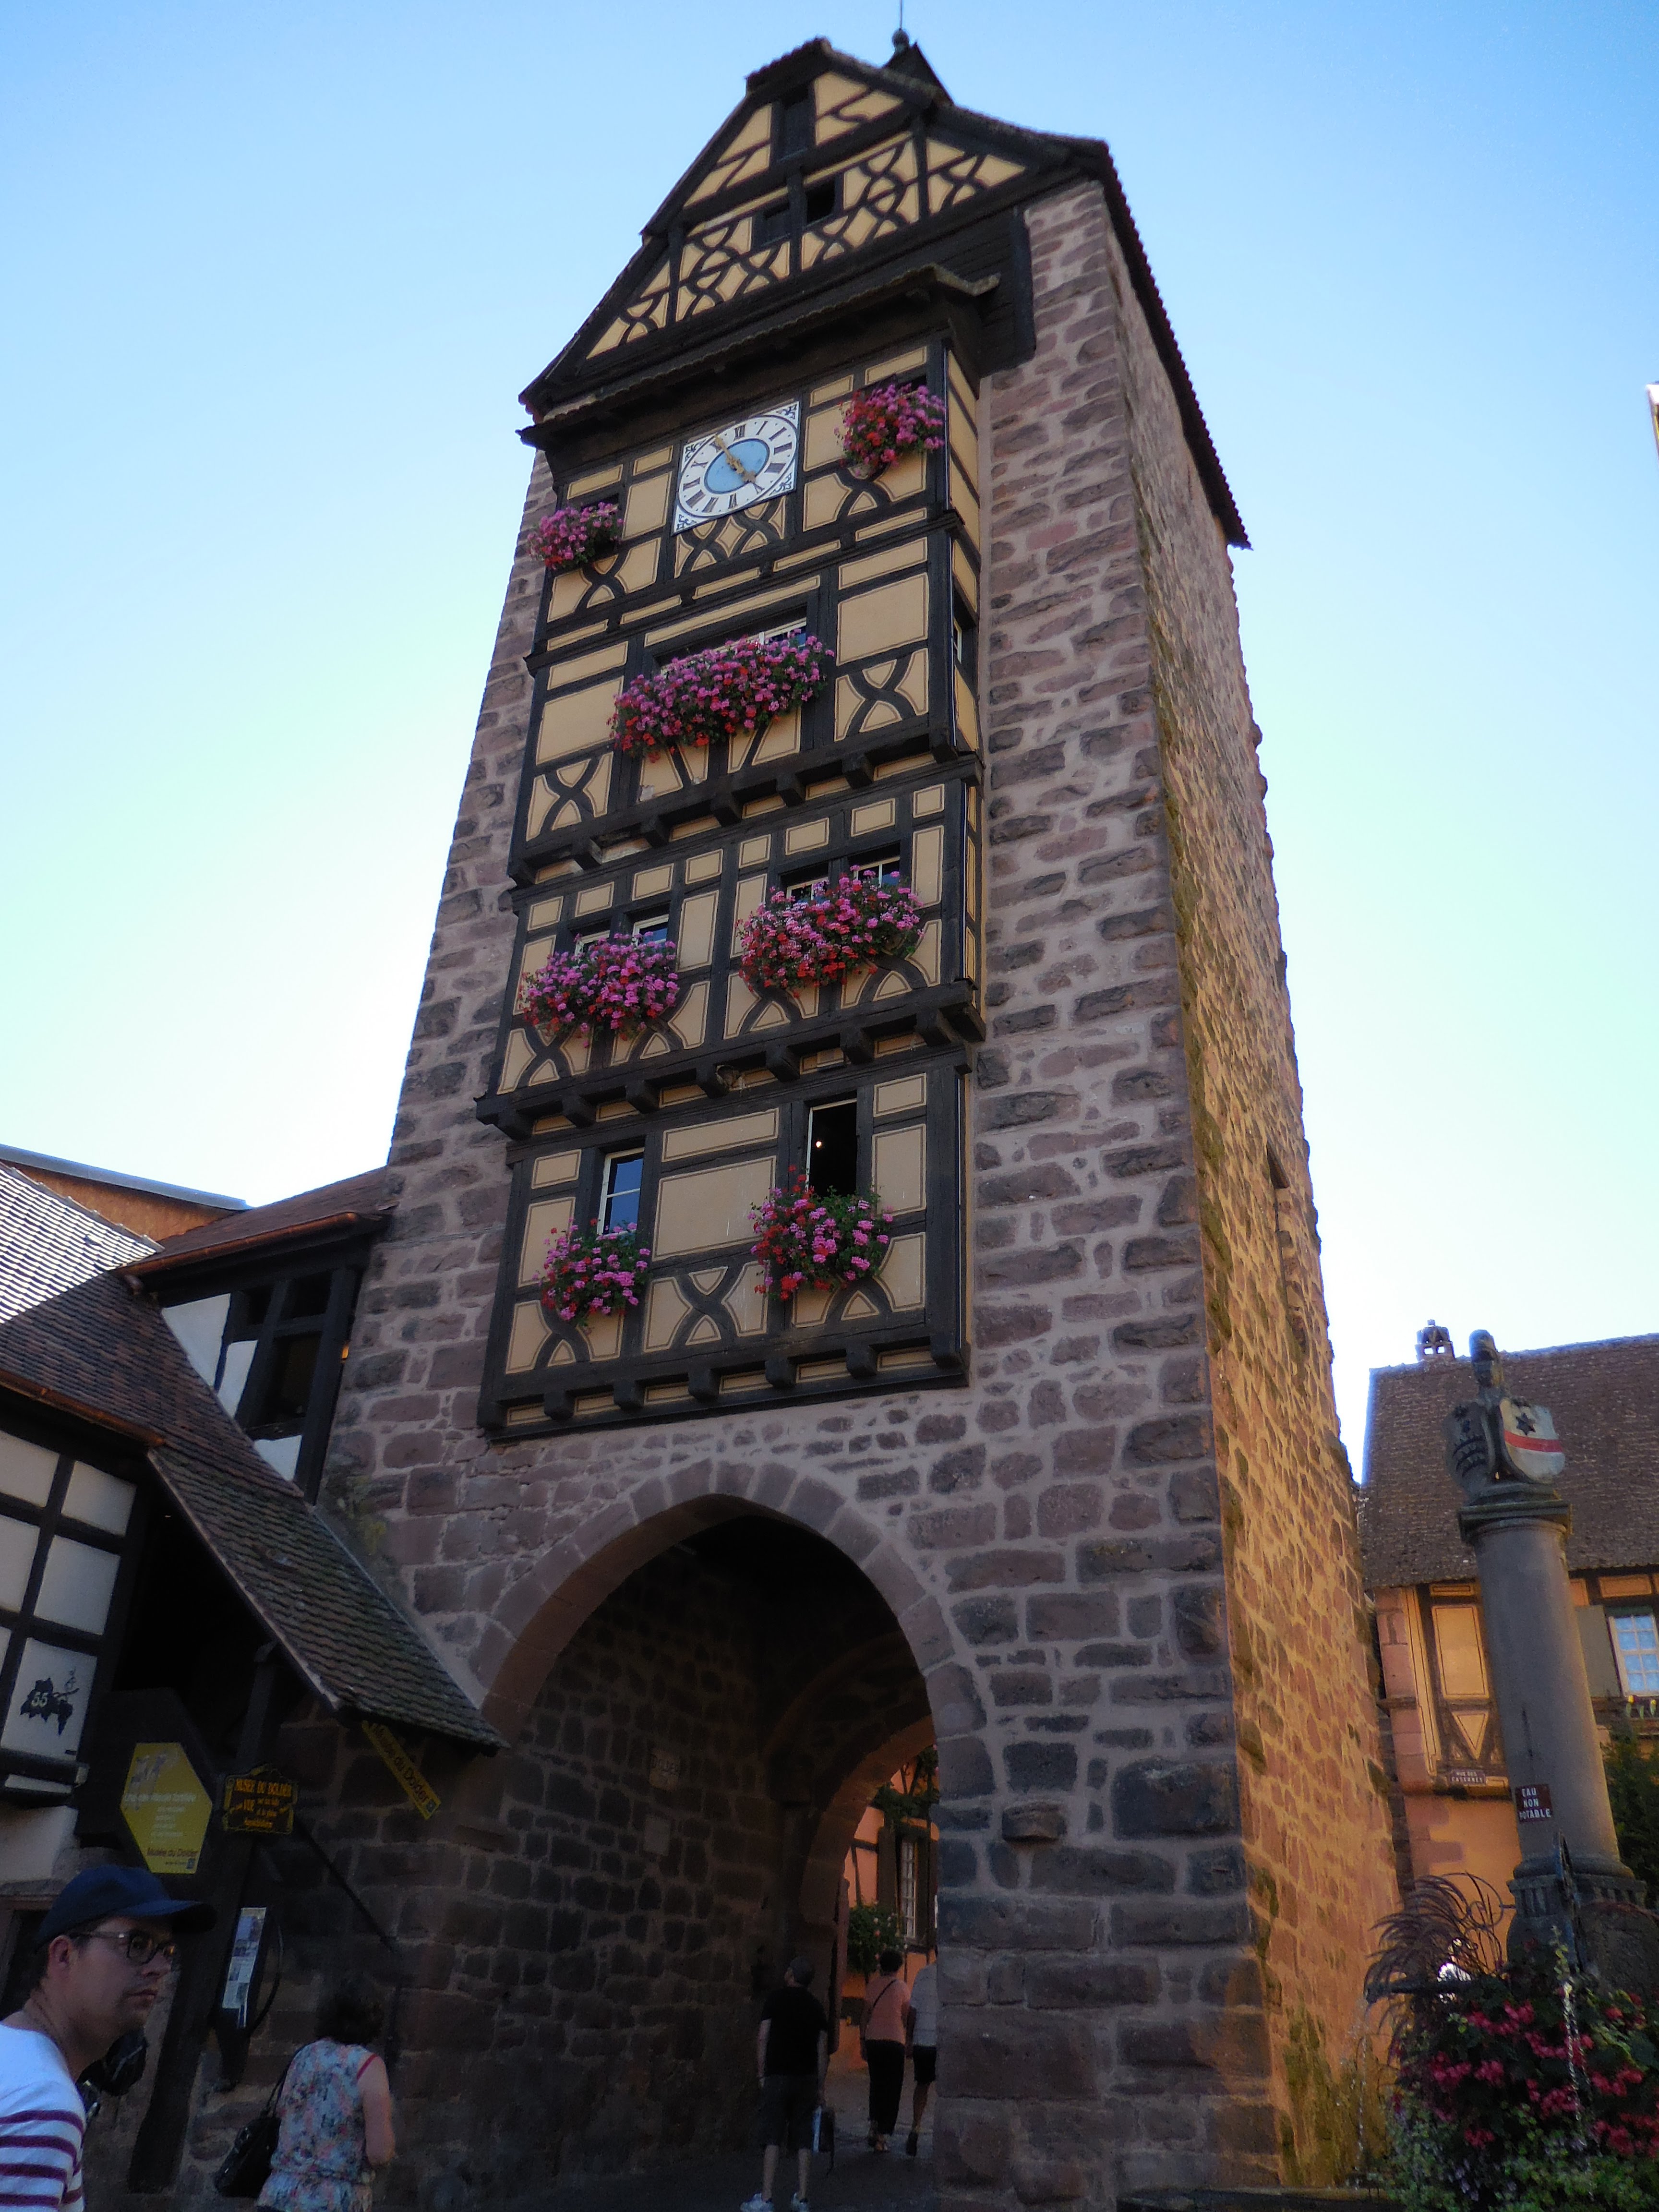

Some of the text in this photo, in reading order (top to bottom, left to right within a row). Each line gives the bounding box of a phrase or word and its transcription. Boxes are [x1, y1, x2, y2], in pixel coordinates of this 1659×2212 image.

[31, 1692, 48, 1707] 55
[403, 1766, 429, 1803] Dolder
[1522, 1787, 1537, 1797] EAU
[1523, 1798, 1539, 1808] NON
[1519, 1808, 1551, 1820] POTABLE
